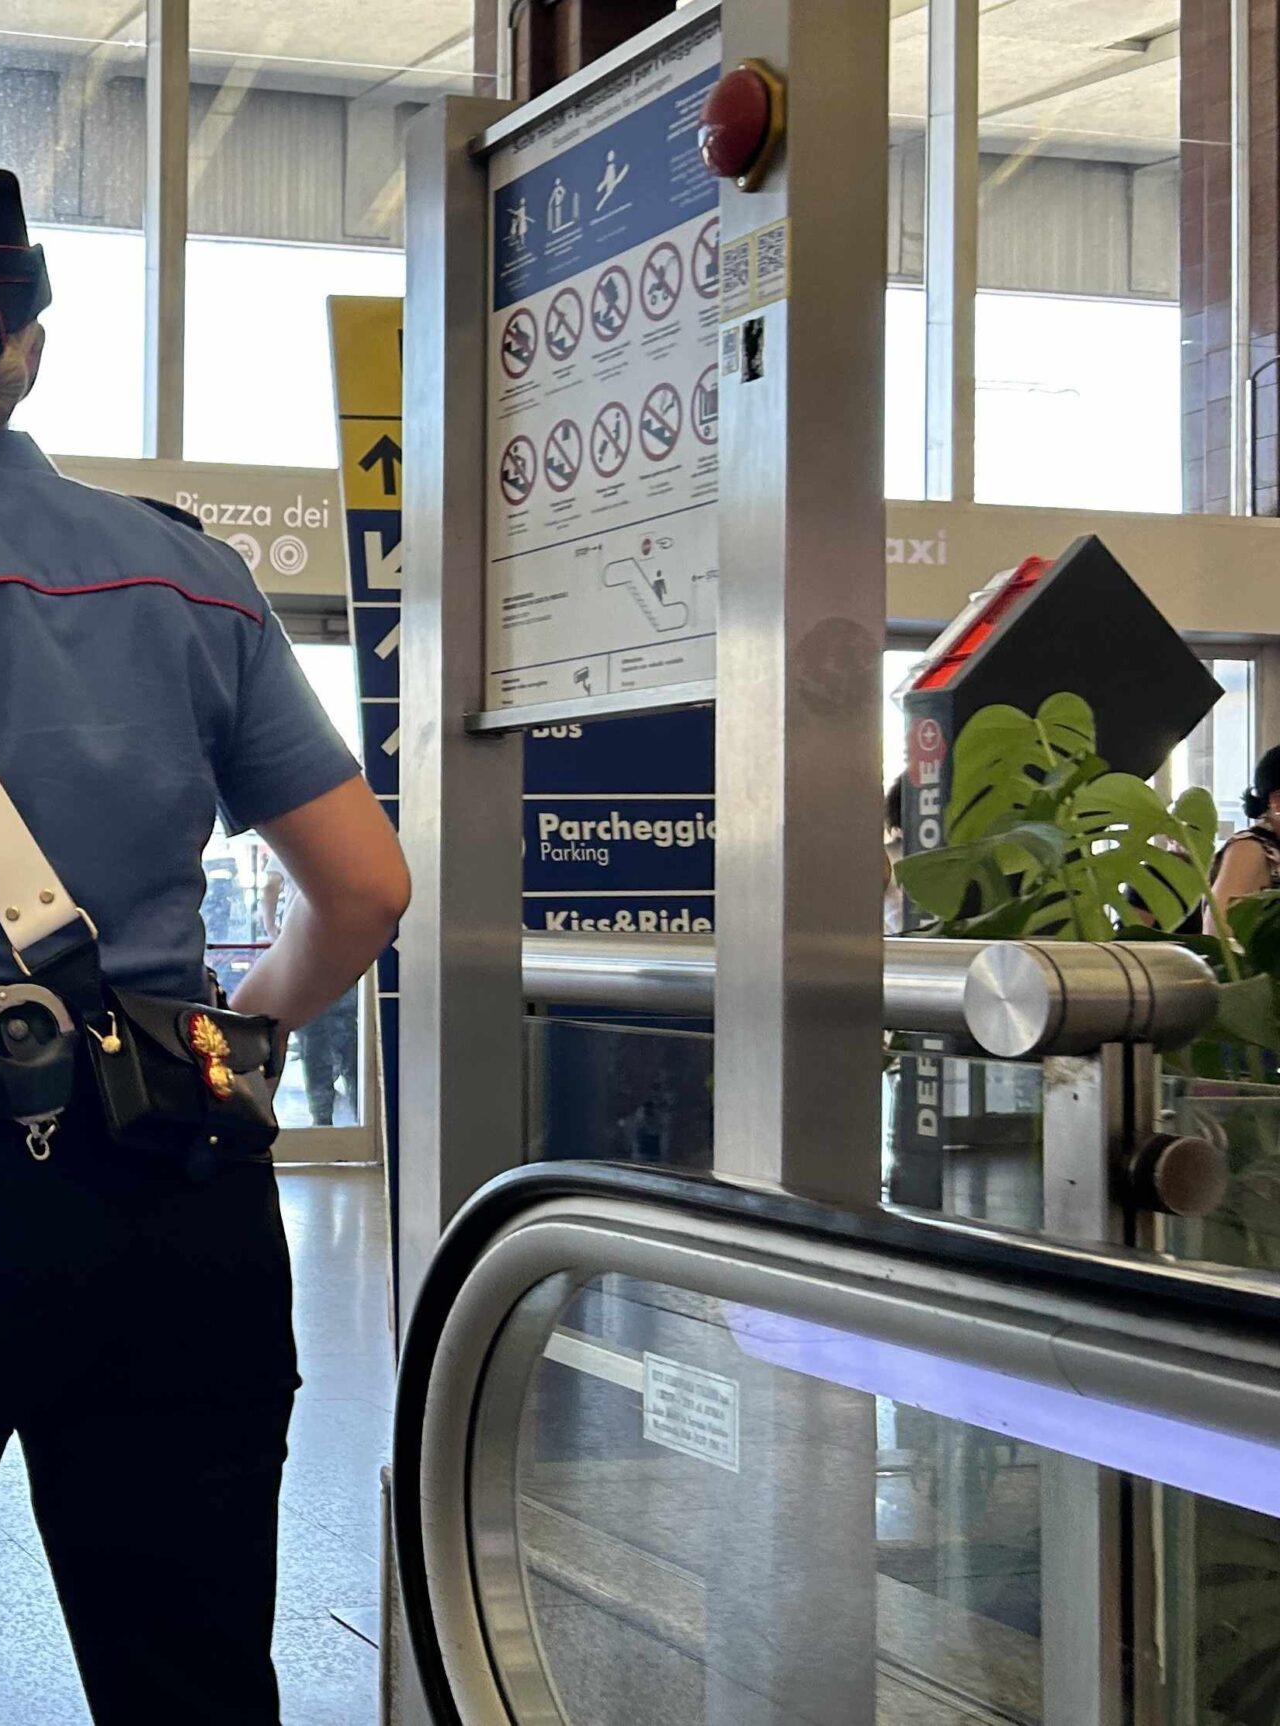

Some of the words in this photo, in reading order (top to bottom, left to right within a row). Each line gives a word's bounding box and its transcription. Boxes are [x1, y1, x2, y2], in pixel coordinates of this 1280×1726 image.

[175, 491, 272, 527] Piazza
[283, 494, 329, 529] dei
[885, 529, 947, 565] axi
[540, 842, 609, 867] Parking
